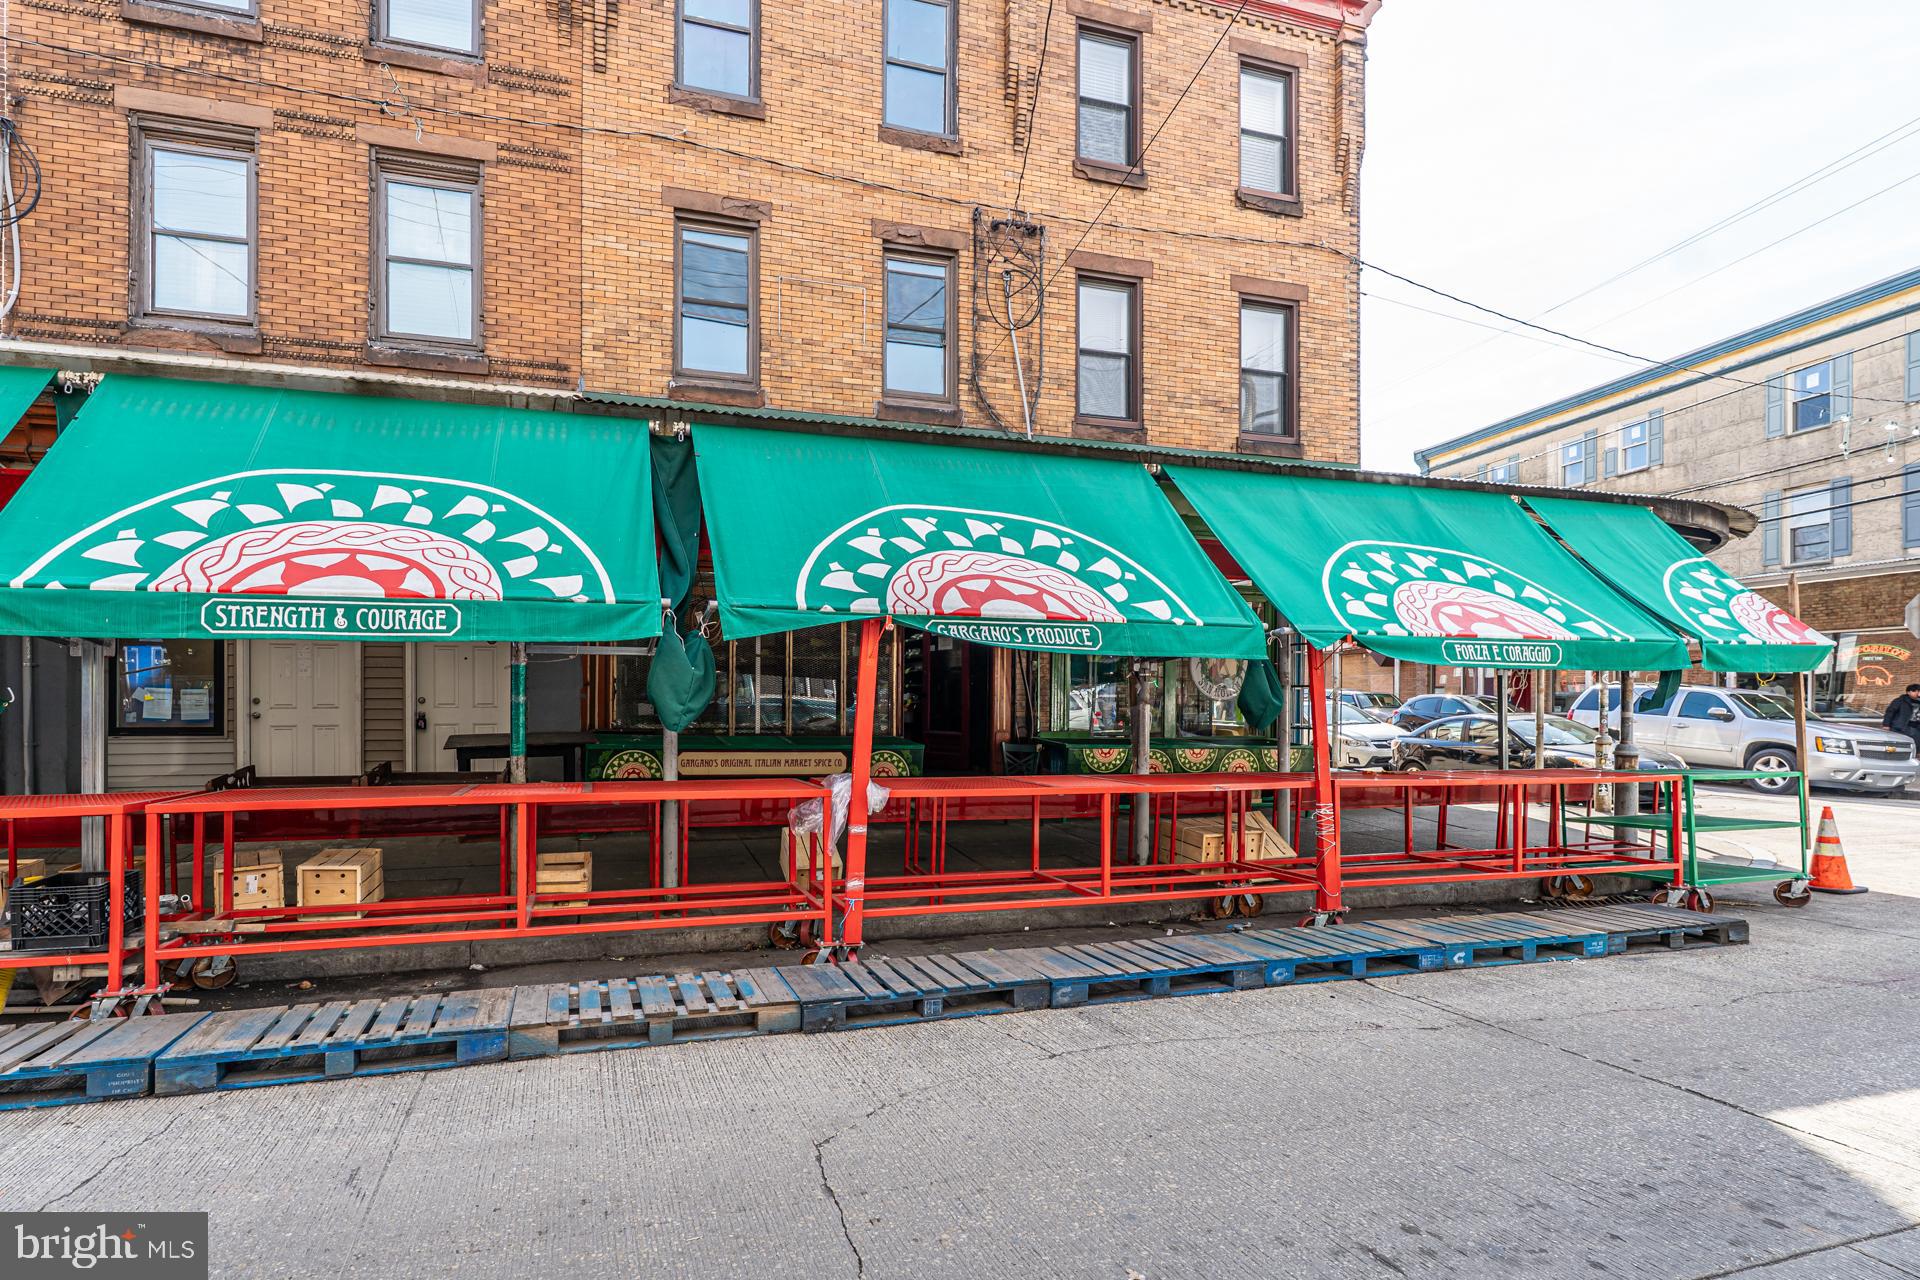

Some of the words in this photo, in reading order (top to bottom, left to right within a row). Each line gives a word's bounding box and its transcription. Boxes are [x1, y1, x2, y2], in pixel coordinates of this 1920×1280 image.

[215, 604, 326, 628] STRENGTH
[333, 607, 348, 629] &
[356, 608, 447, 630] COURAGE
[937, 624, 1022, 642] GARGANO'S
[1025, 627, 1093, 646] PRODUCE
[1453, 643, 1491, 660] FORZA
[1492, 645, 1502, 660] E
[1503, 645, 1551, 662] CORAGGIO
[680, 758, 719, 768] GARGANO'S
[720, 758, 753, 768] ORIGINAL
[755, 758, 782, 768] ITALIAN
[784, 758, 812, 768] MARKET
[814, 758, 832, 767] SPICE
